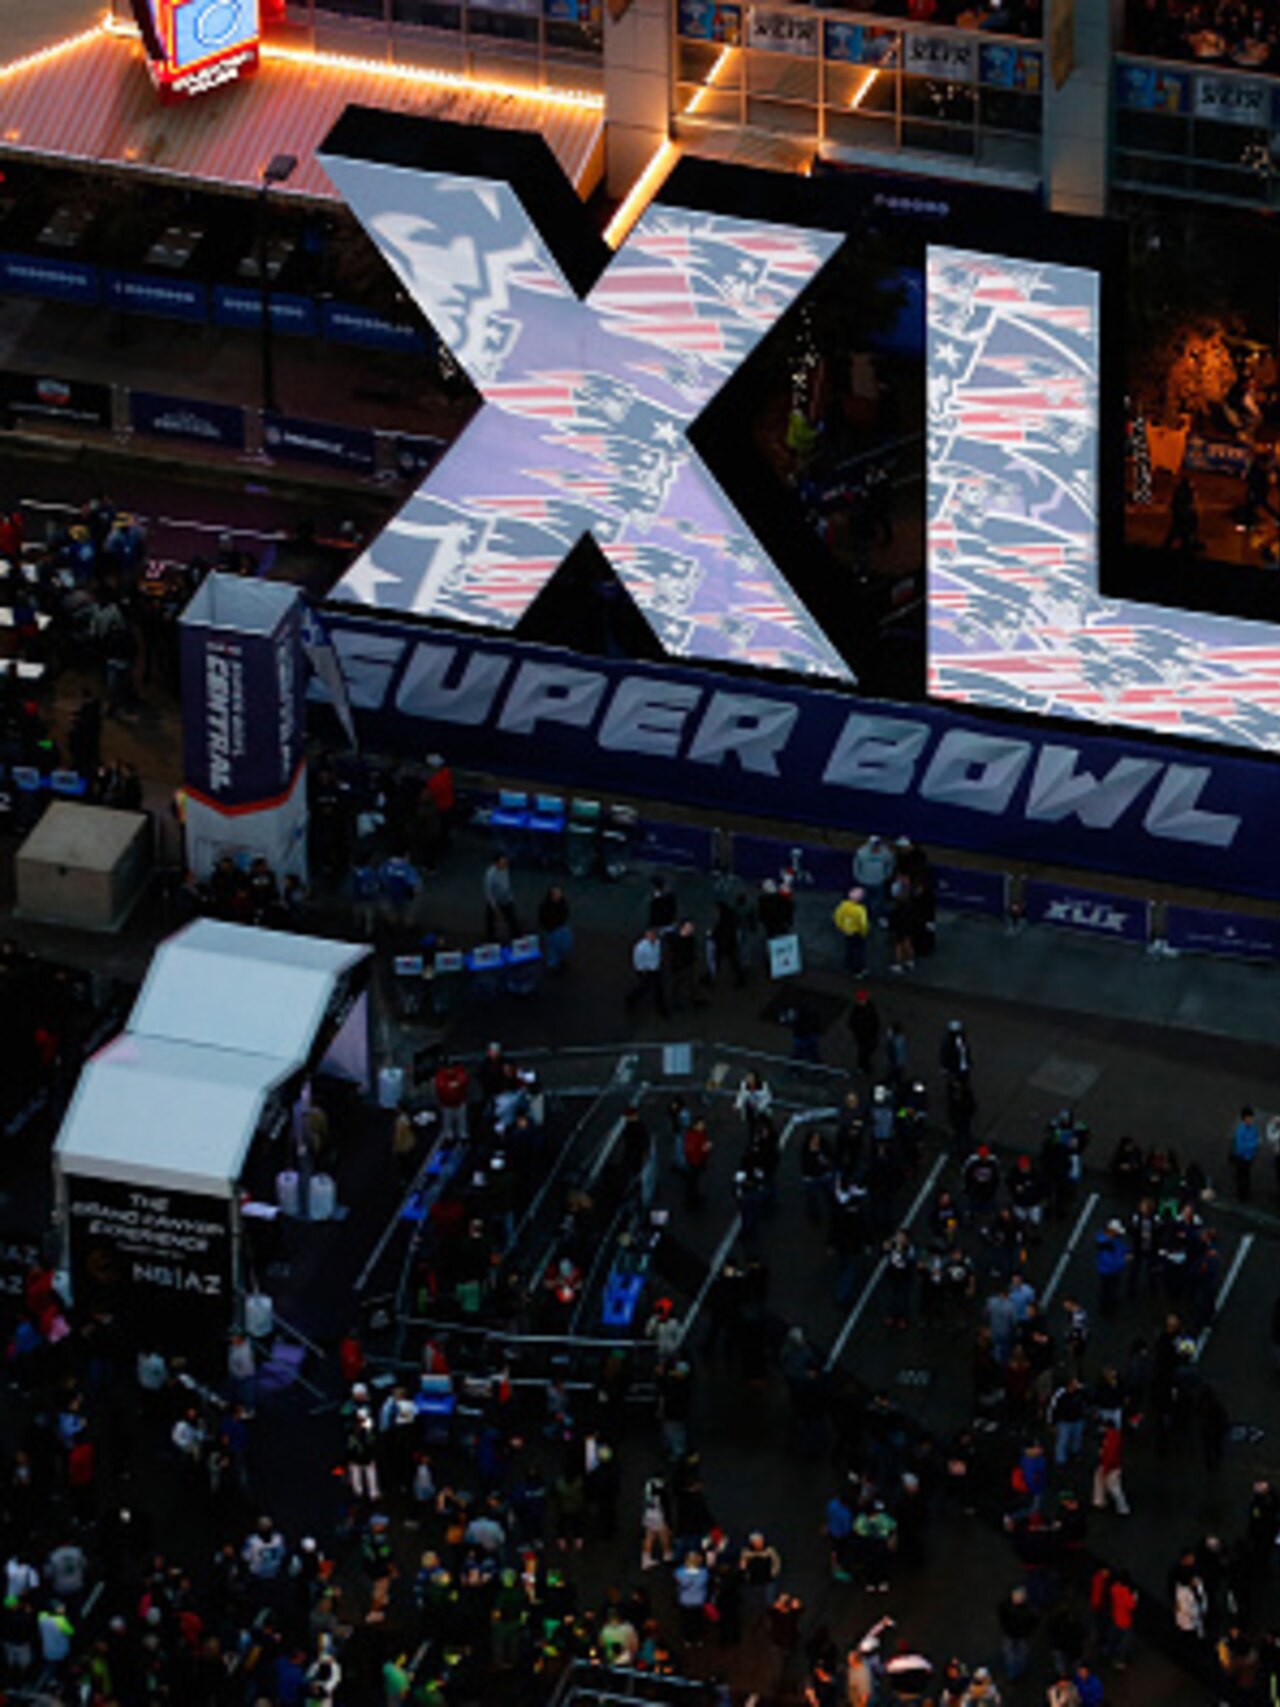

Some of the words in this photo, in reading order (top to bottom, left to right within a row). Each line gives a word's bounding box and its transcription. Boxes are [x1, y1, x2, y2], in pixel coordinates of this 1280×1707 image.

[204, 655, 233, 793] CENTRAL
[305, 627, 801, 777] SUPER
[821, 709, 1243, 848] BOWL
[1043, 898, 1130, 932] XLIX
[128, 1192, 170, 1213] THE
